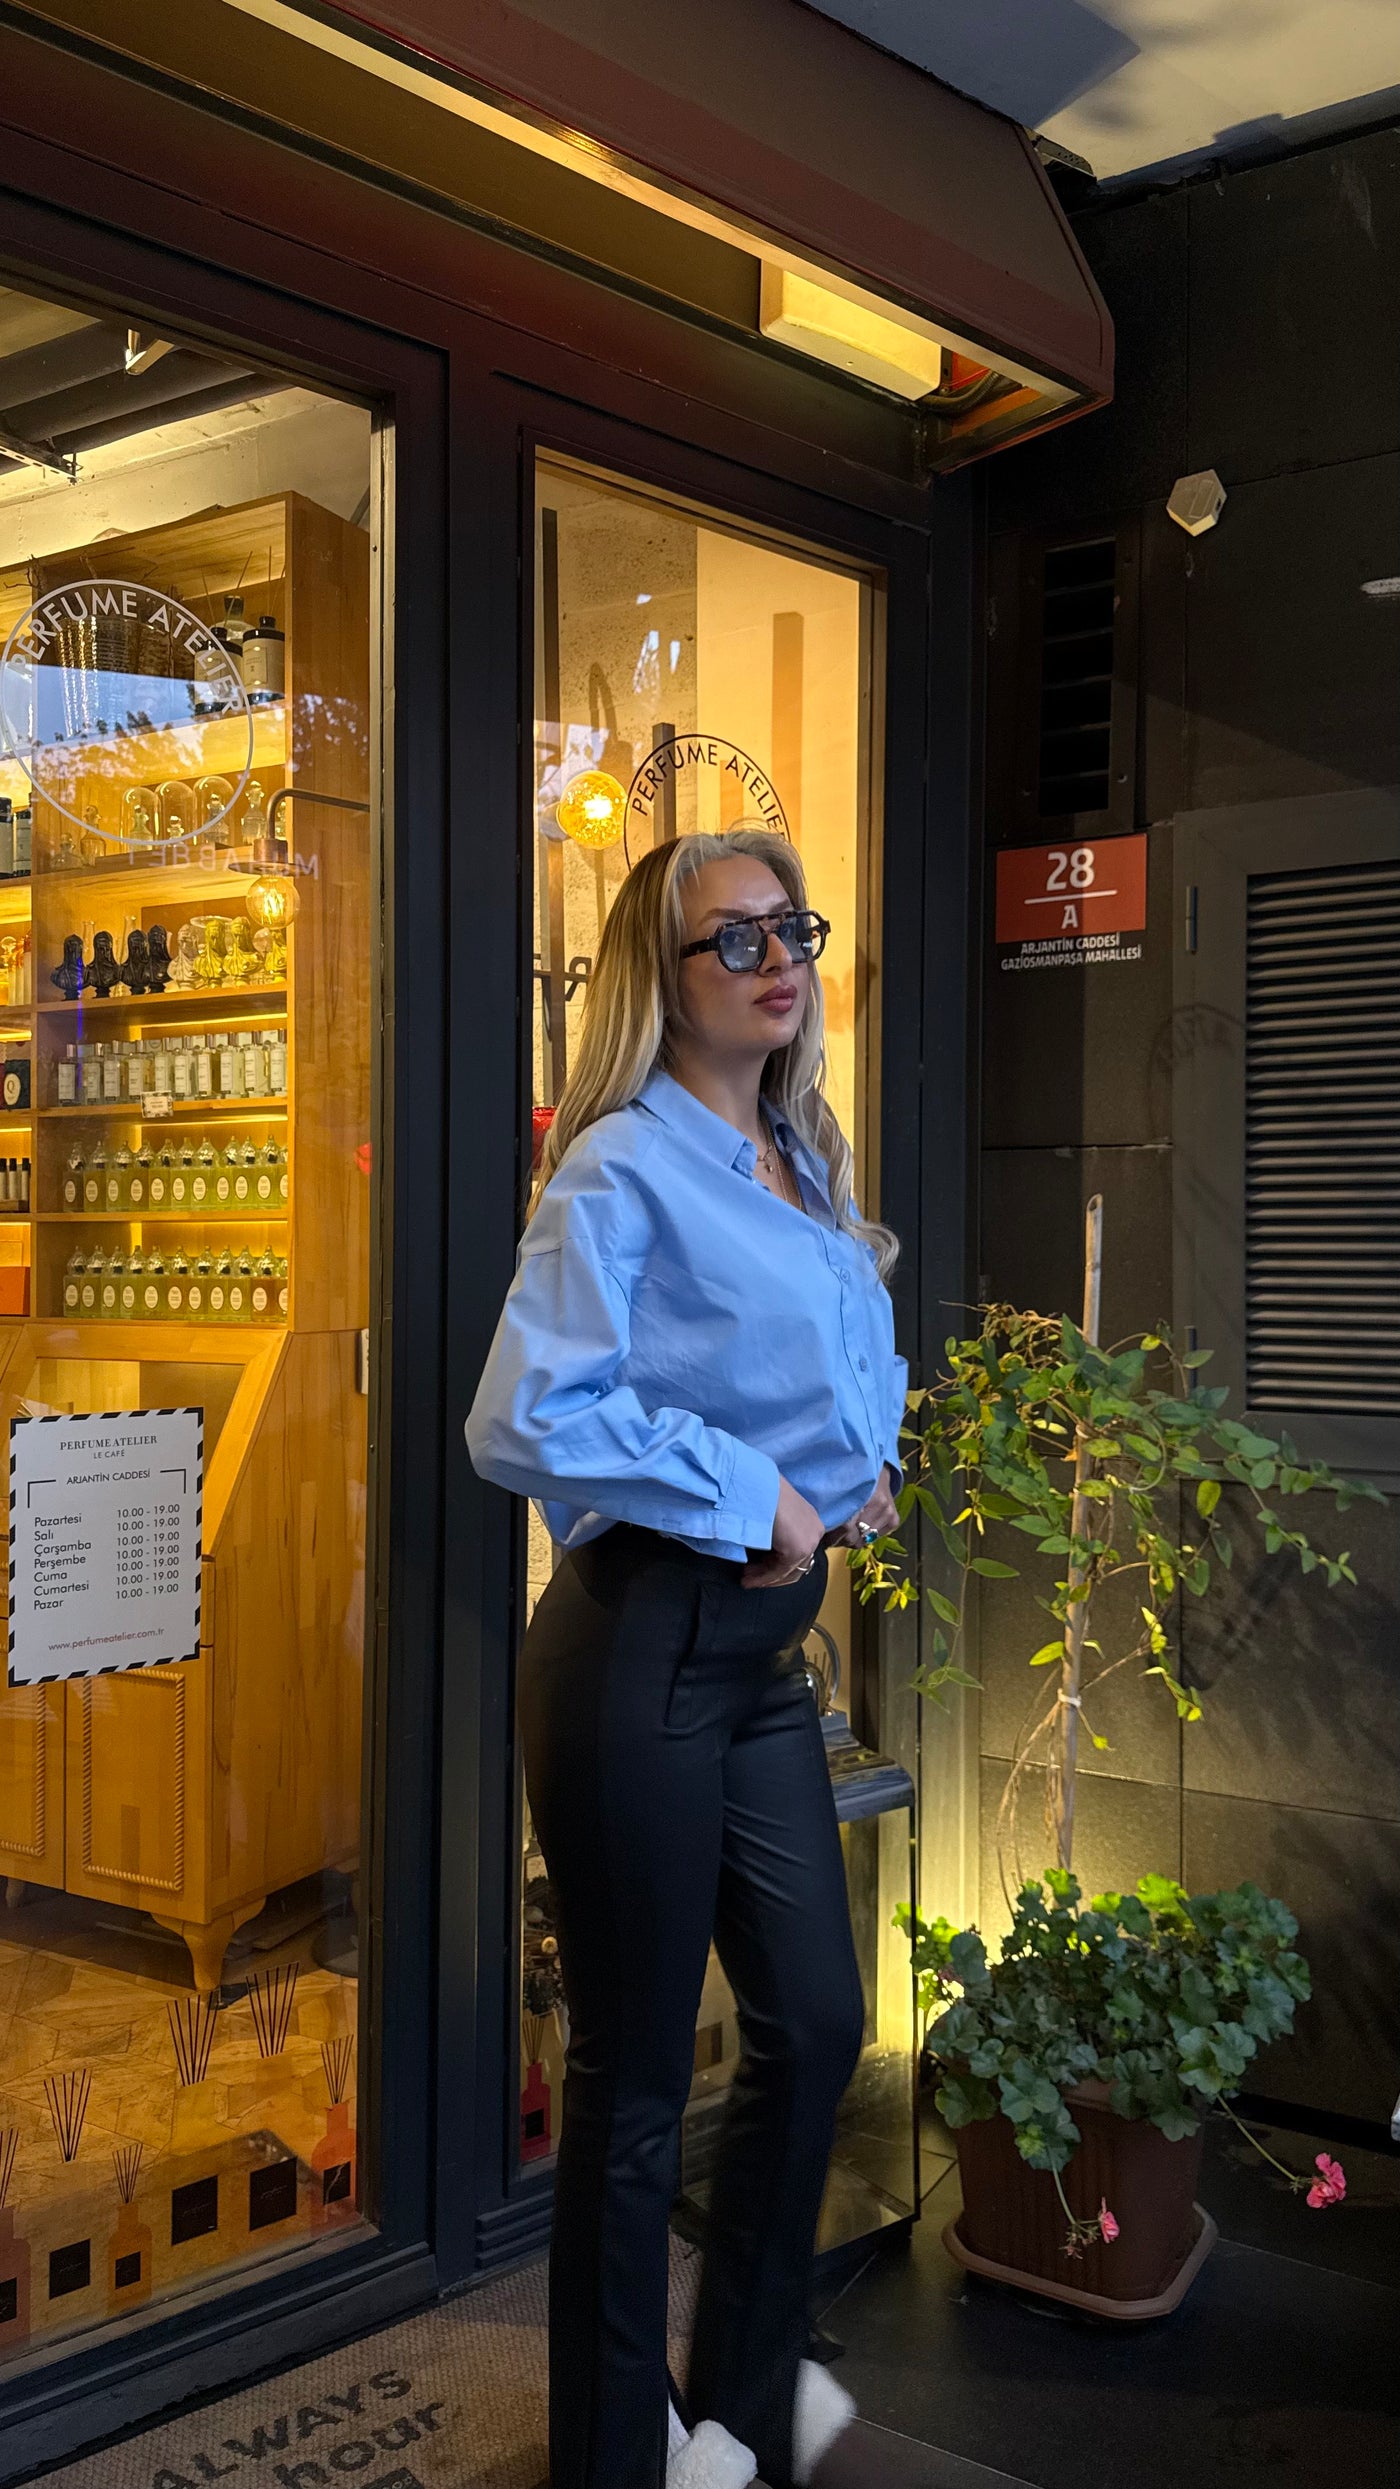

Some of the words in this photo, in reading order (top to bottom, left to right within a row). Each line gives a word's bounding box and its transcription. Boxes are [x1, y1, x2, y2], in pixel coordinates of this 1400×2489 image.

[7, 588, 139, 677] PERFUME
[148, 604, 243, 715] ATELIER
[632, 742, 718, 816] PERFUME
[725, 755, 786, 836] ATELIE
[1046, 847, 1095, 892] 28
[1061, 904, 1078, 929] A
[1020, 938, 1074, 954] ARJANTİN
[1076, 932, 1120, 949] CADDESİ
[1001, 953, 1083, 970] GAZİOSMANPAŞA
[1085, 944, 1142, 962] MAHALLESİ
[60, 1439, 113, 1451] PERFUME
[113, 1435, 157, 1448] ATELIER
[105, 1449, 125, 1458] CAFÉ
[67, 1473, 110, 1485] ARJANTİN
[112, 1468, 150, 1481] CADDESİ
[34, 1512, 82, 1527] Pazartesi
[117, 1508, 144, 1519] 10.00
[154, 1504, 180, 1515] 19.00
[34, 1530, 54, 1541] Salı
[117, 1521, 144, 1532] 10.00
[154, 1517, 180, 1528] 19.00
[34, 1541, 92, 1556] Çarşamba
[117, 1535, 144, 1546] 10.00
[154, 1531, 180, 1542] 19.00
[34, 1555, 86, 1570] Perşembe
[117, 1549, 144, 1560] 10.00
[154, 1545, 180, 1556] 19.00
[34, 1572, 68, 1583] Cuma
[117, 1561, 144, 1572] 10.00
[154, 1557, 180, 1568] 19.00
[34, 1580, 90, 1597] Cumartesi
[117, 1574, 144, 1585] 10.00
[154, 1570, 180, 1581] 19.00
[34, 1599, 64, 1611] Pazar
[117, 1588, 144, 1600] 10.00
[154, 1584, 180, 1594] 19.00
[49, 1627, 164, 1651] www.perfumeatelier.com.tr
[153, 2369, 412, 2489] ALWAYS
[273, 2402, 444, 2489] hour
